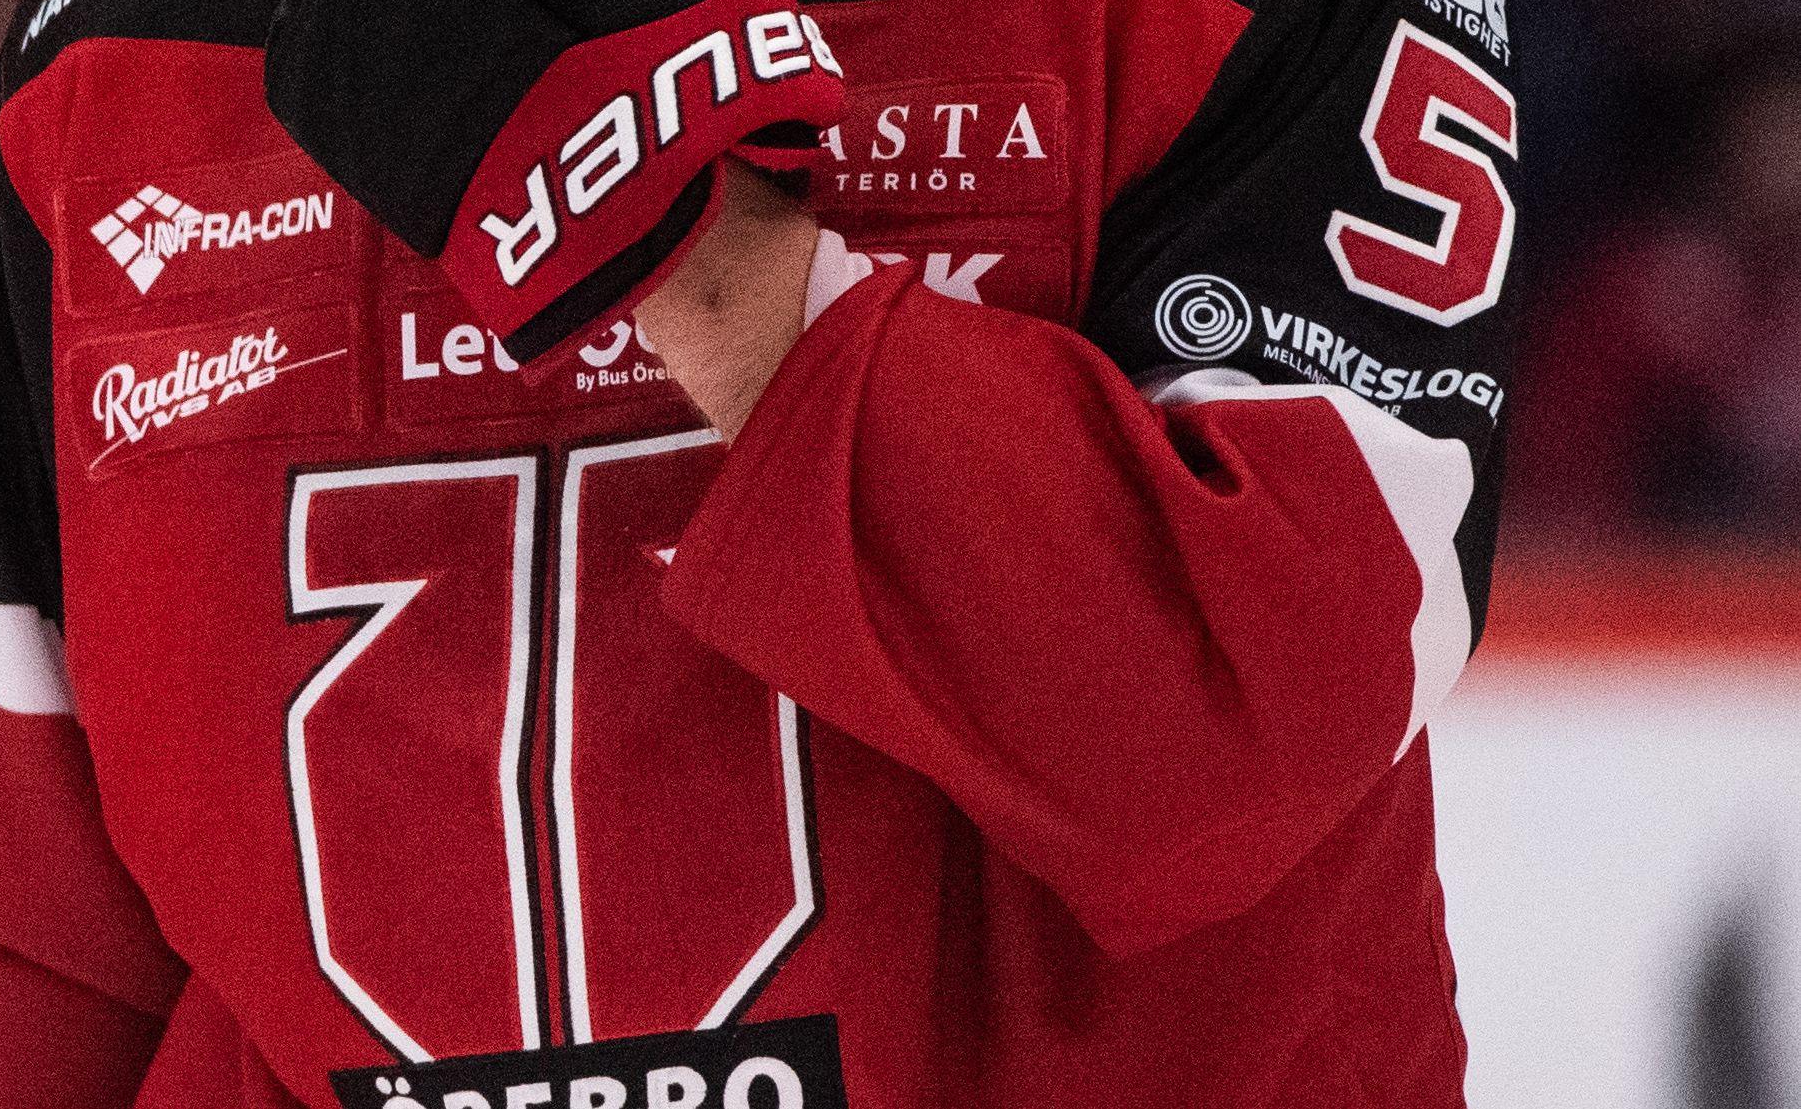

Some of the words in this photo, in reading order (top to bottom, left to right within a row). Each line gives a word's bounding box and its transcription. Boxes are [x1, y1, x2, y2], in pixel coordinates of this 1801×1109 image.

[479, 11, 843, 286] BAUER
[1324, 18, 1517, 327] 5
[143, 192, 334, 260] INFRA-CON
[217, 365, 277, 405] AB
[576, 372, 598, 392] By
[598, 370, 629, 387] Bus
